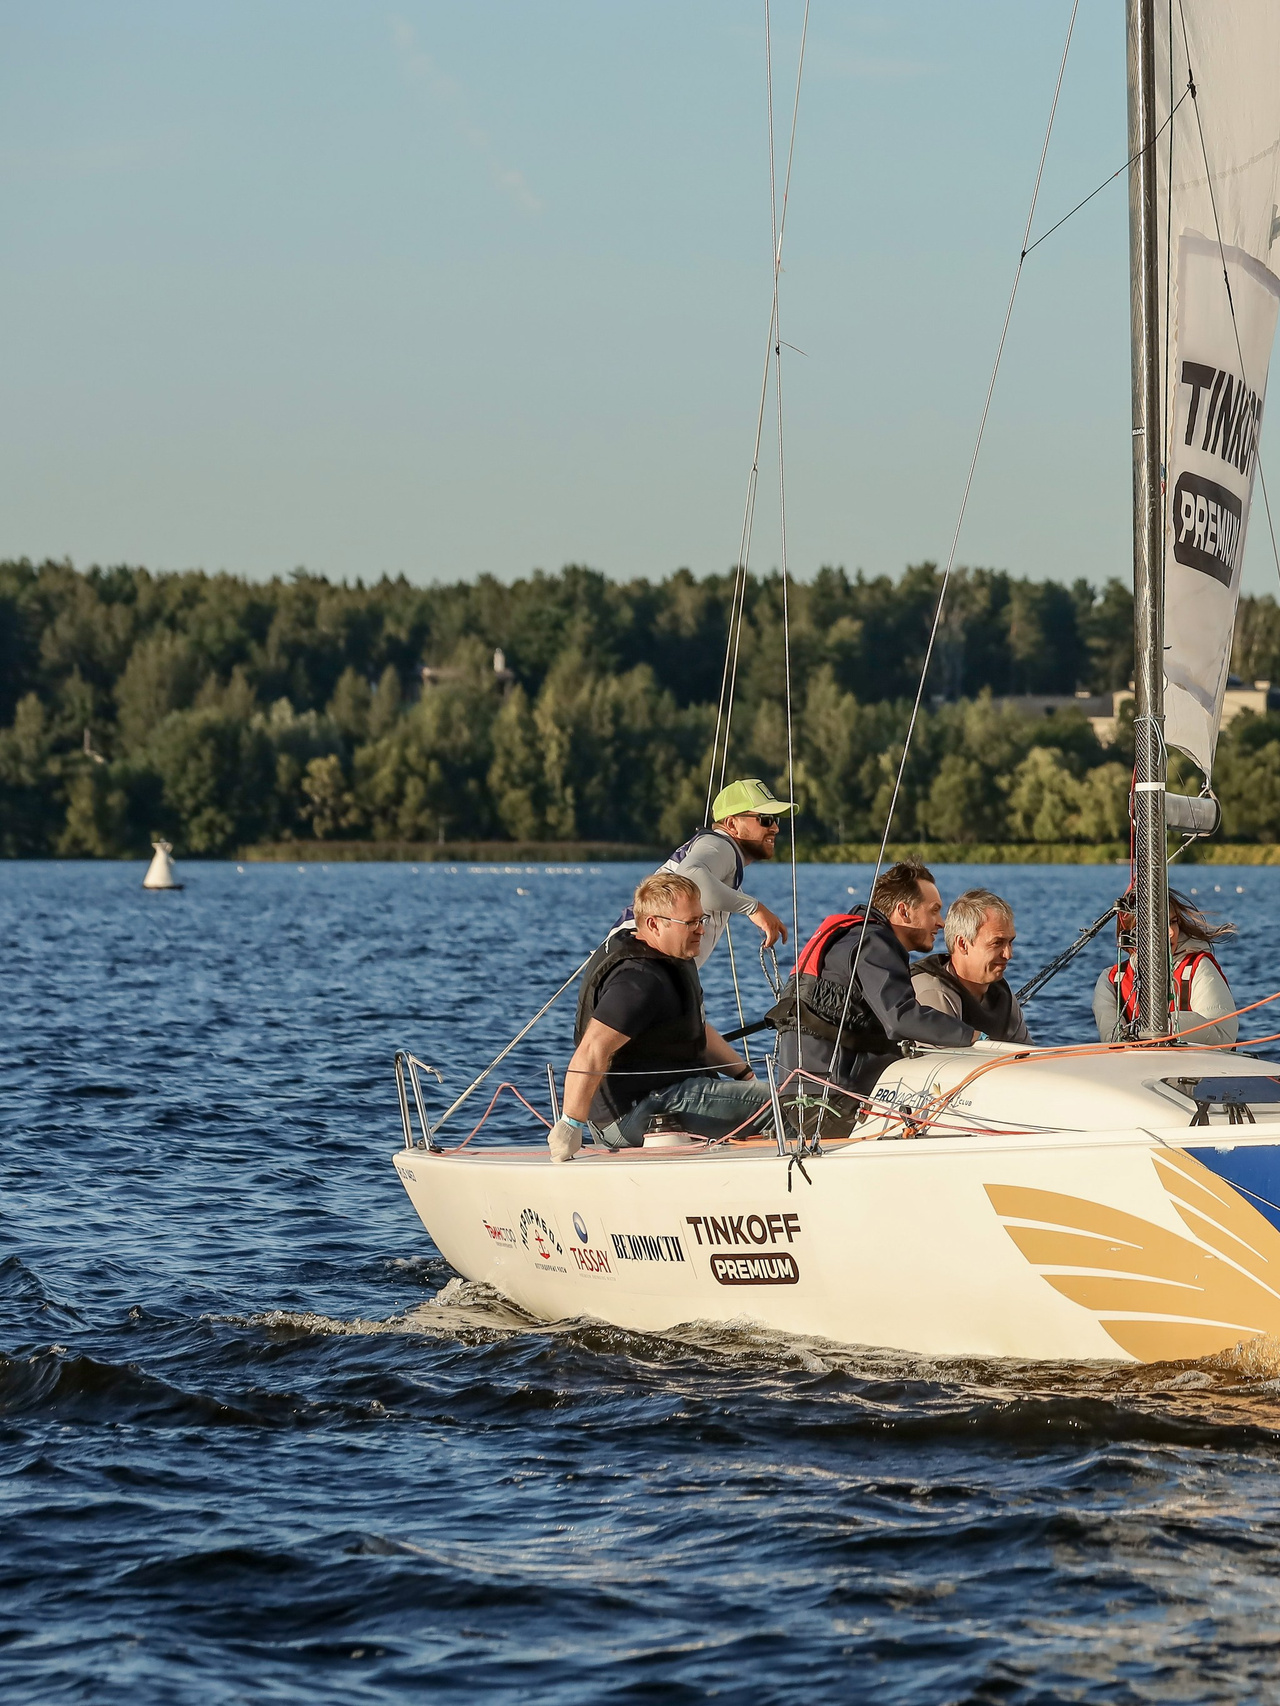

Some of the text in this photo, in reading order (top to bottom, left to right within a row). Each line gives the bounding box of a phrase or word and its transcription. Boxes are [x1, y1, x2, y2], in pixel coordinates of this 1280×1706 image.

[1181, 361, 1263, 479] TINKOF
[686, 1213, 802, 1245] TINKOFF
[569, 1247, 612, 1273] TASSAY
[611, 1233, 686, 1262] ВЕДОМОСТИ
[713, 1258, 795, 1280] PREMIUM
